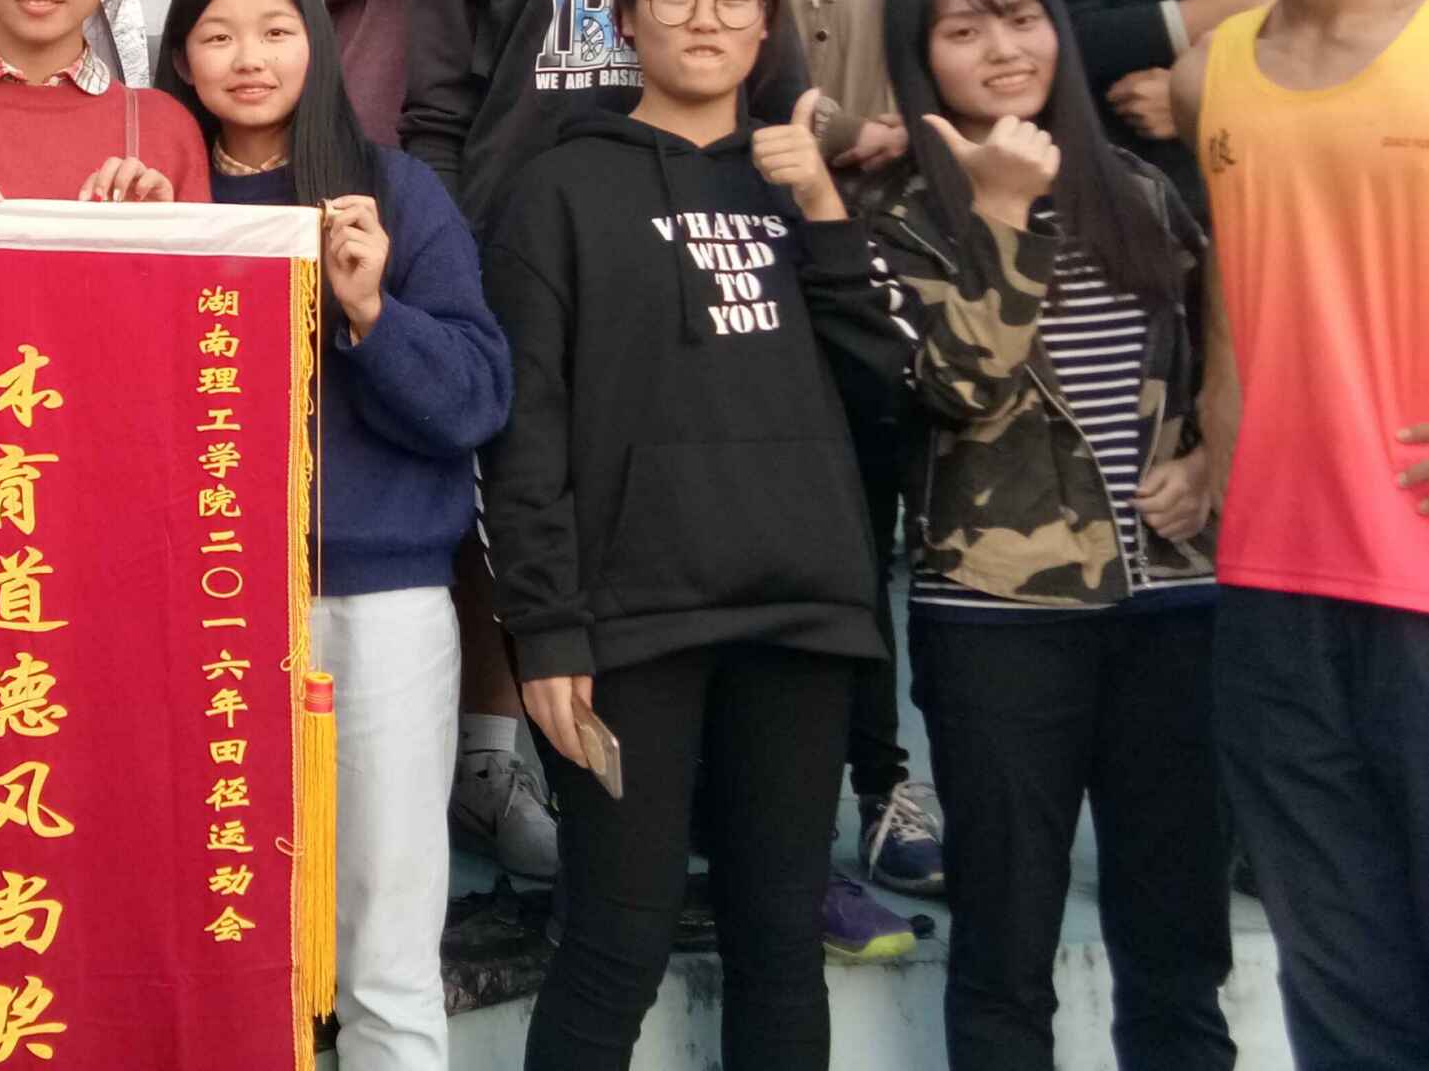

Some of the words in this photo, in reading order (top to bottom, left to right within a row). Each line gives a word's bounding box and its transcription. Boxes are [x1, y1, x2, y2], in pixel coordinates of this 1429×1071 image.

[536, 73, 559, 90] WE
[565, 71, 593, 89] ARE
[599, 69, 645, 87] BASKE
[686, 241, 776, 271] WILD
[714, 271, 762, 302] TO
[707, 301, 781, 336] YOU
[196, 285, 256, 943] 湖南理工学院二〇一六年田径运动会
